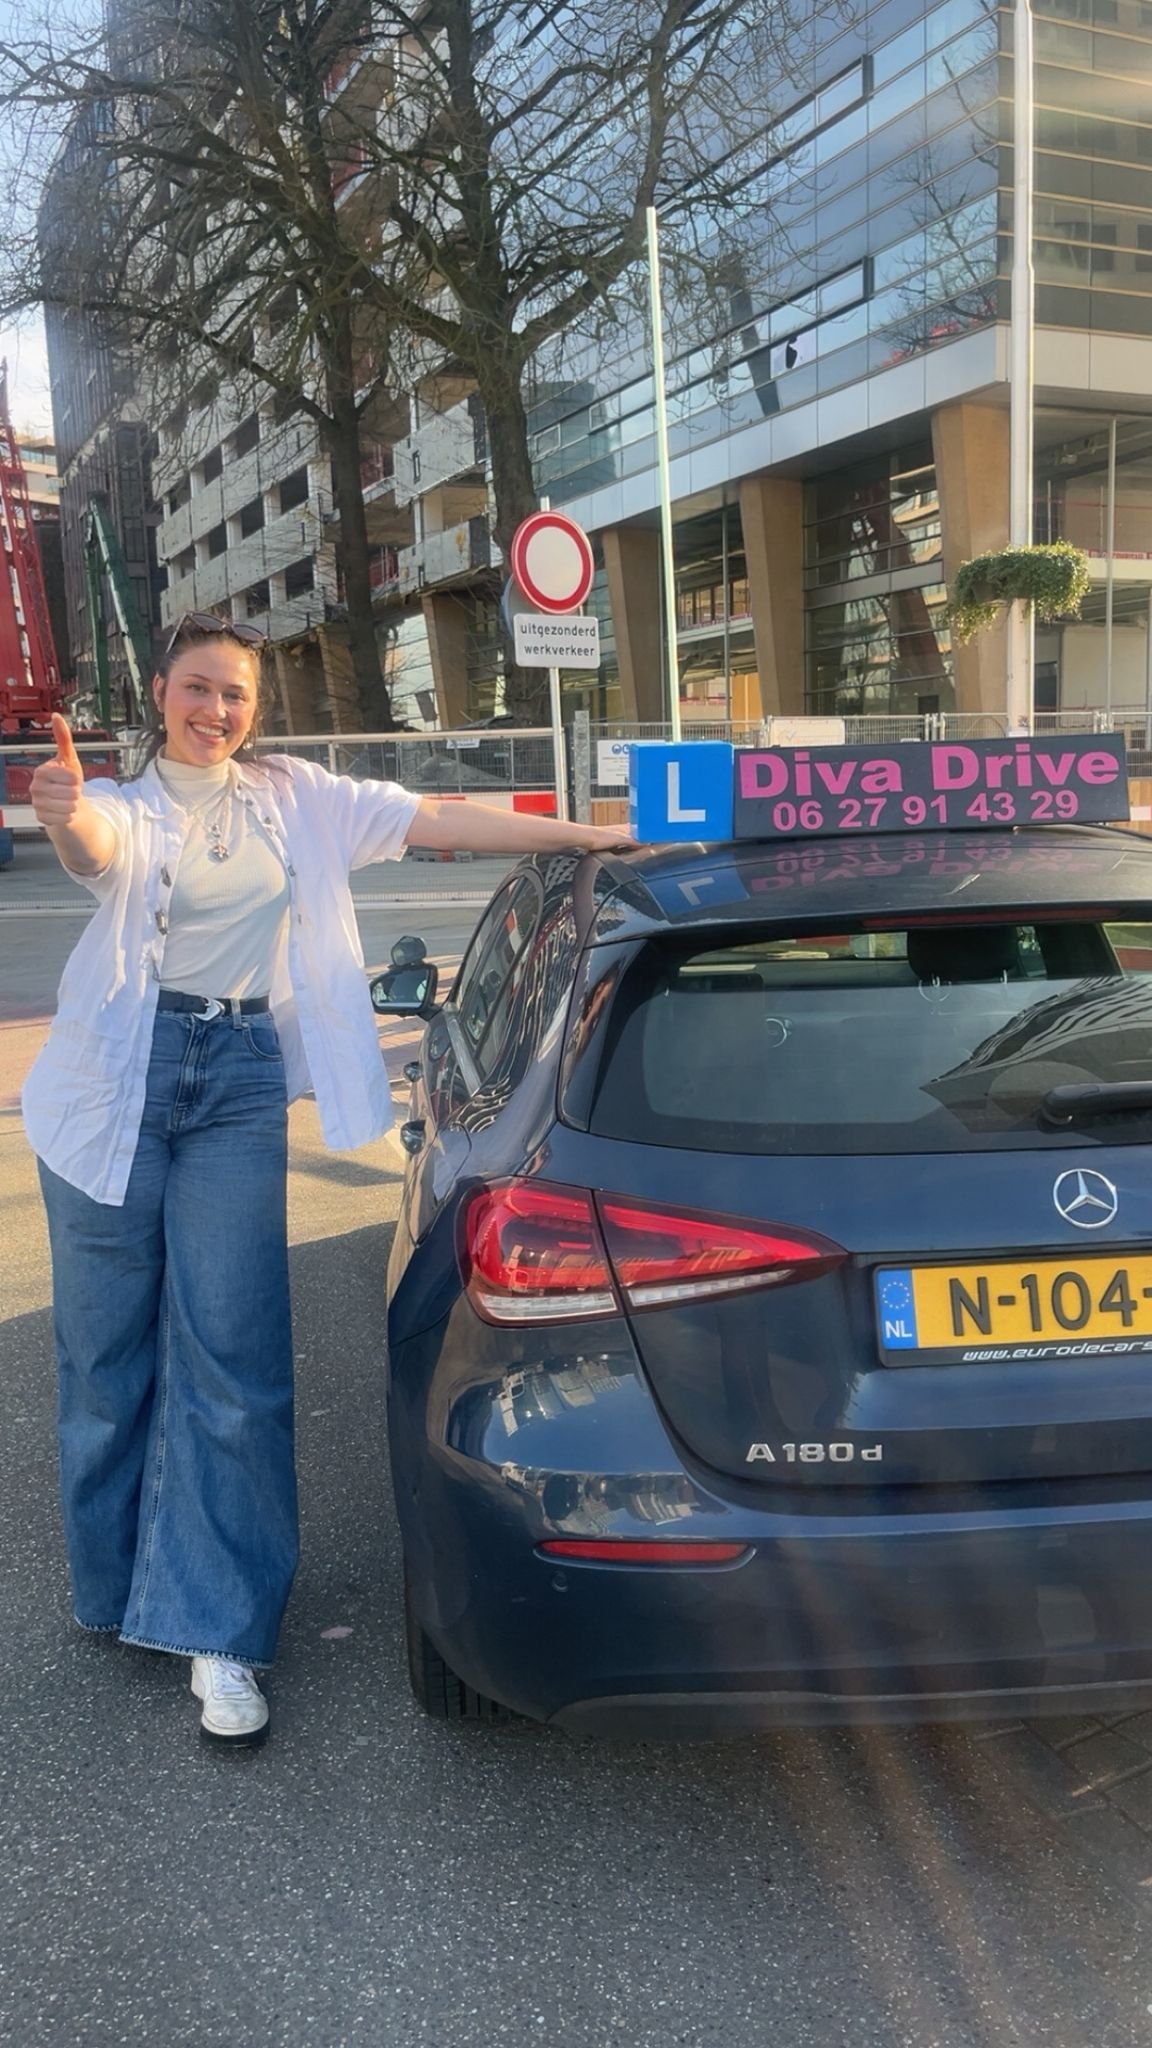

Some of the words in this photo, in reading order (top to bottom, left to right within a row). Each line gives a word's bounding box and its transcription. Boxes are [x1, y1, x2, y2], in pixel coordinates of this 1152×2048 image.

[521, 623, 596, 637] uitgezonderd
[524, 644, 594, 656] werkverkeer
[740, 753, 902, 799] Diva
[932, 744, 1119, 790] Drive
[667, 762, 705, 823] L
[773, 799, 823, 831] 06
[838, 798, 886, 828] 27
[903, 795, 948, 825] 91
[966, 791, 1016, 822] 43
[1030, 790, 1078, 819] 29
[881, 1319, 912, 1338] NL
